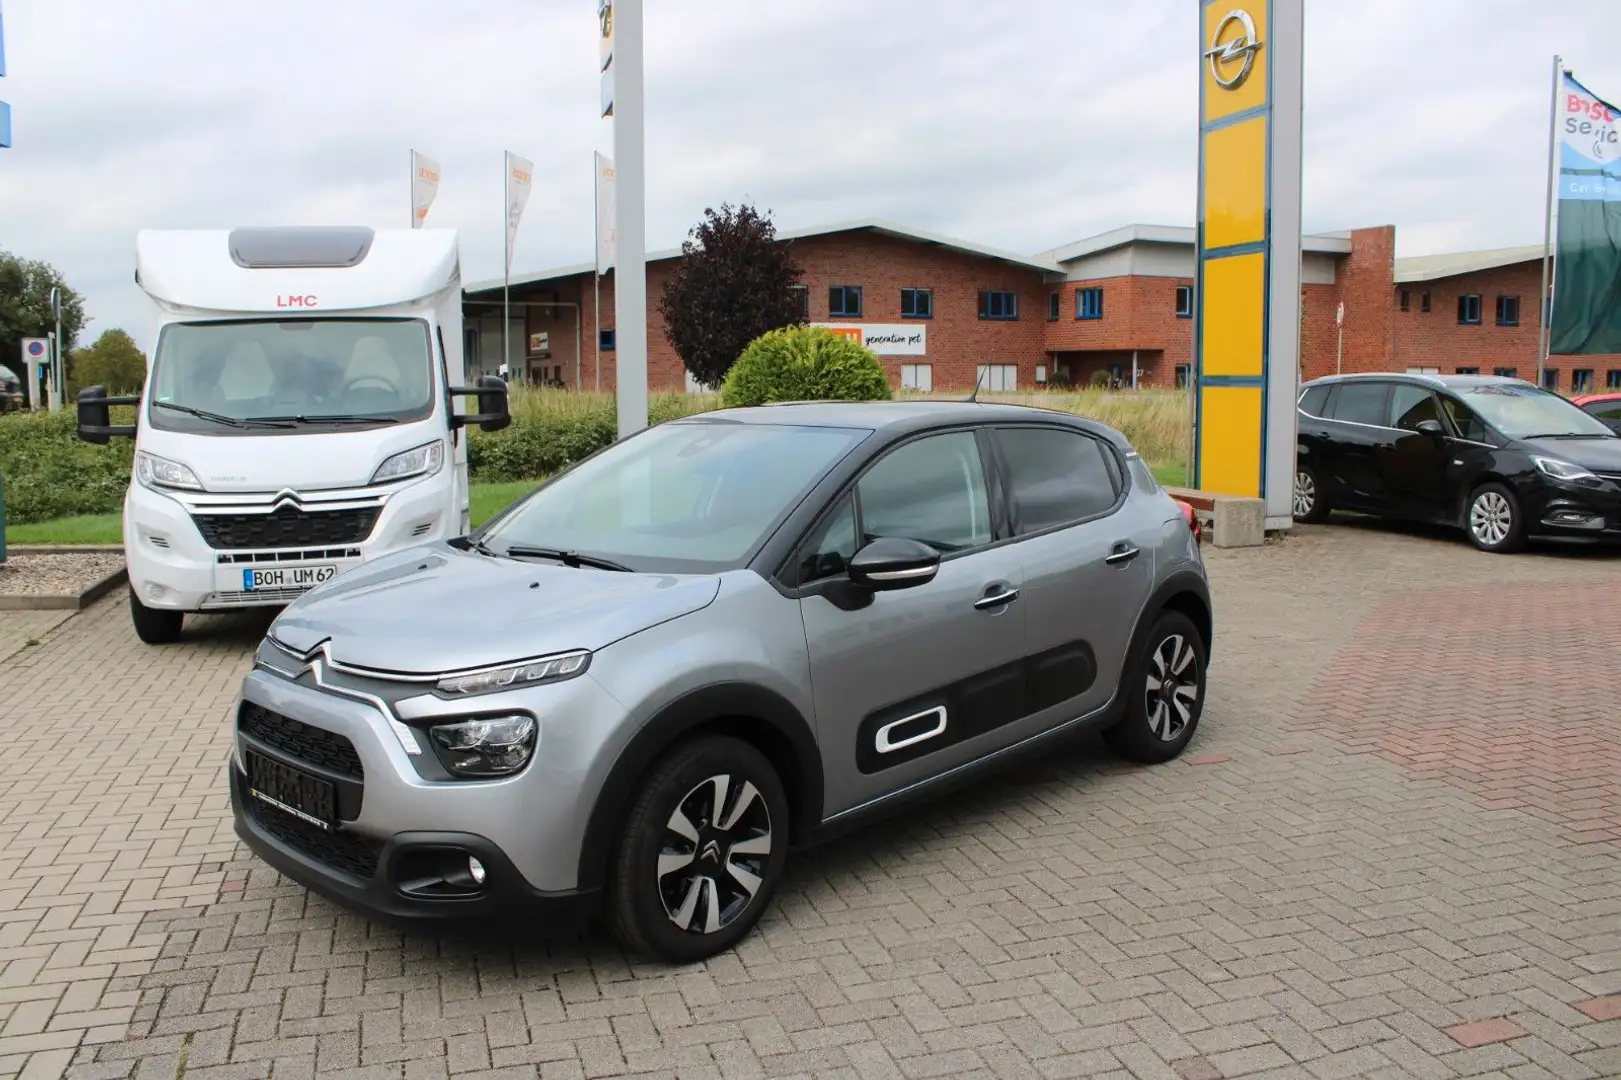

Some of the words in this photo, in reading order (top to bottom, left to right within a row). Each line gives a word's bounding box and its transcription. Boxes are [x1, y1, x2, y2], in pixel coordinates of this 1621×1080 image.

[277, 295, 318, 307] LMC
[865, 333, 906, 346] generation
[908, 333, 922, 346] pet
[254, 570, 284, 586] BOH
[293, 569, 314, 584] UM
[316, 567, 334, 582] 62
